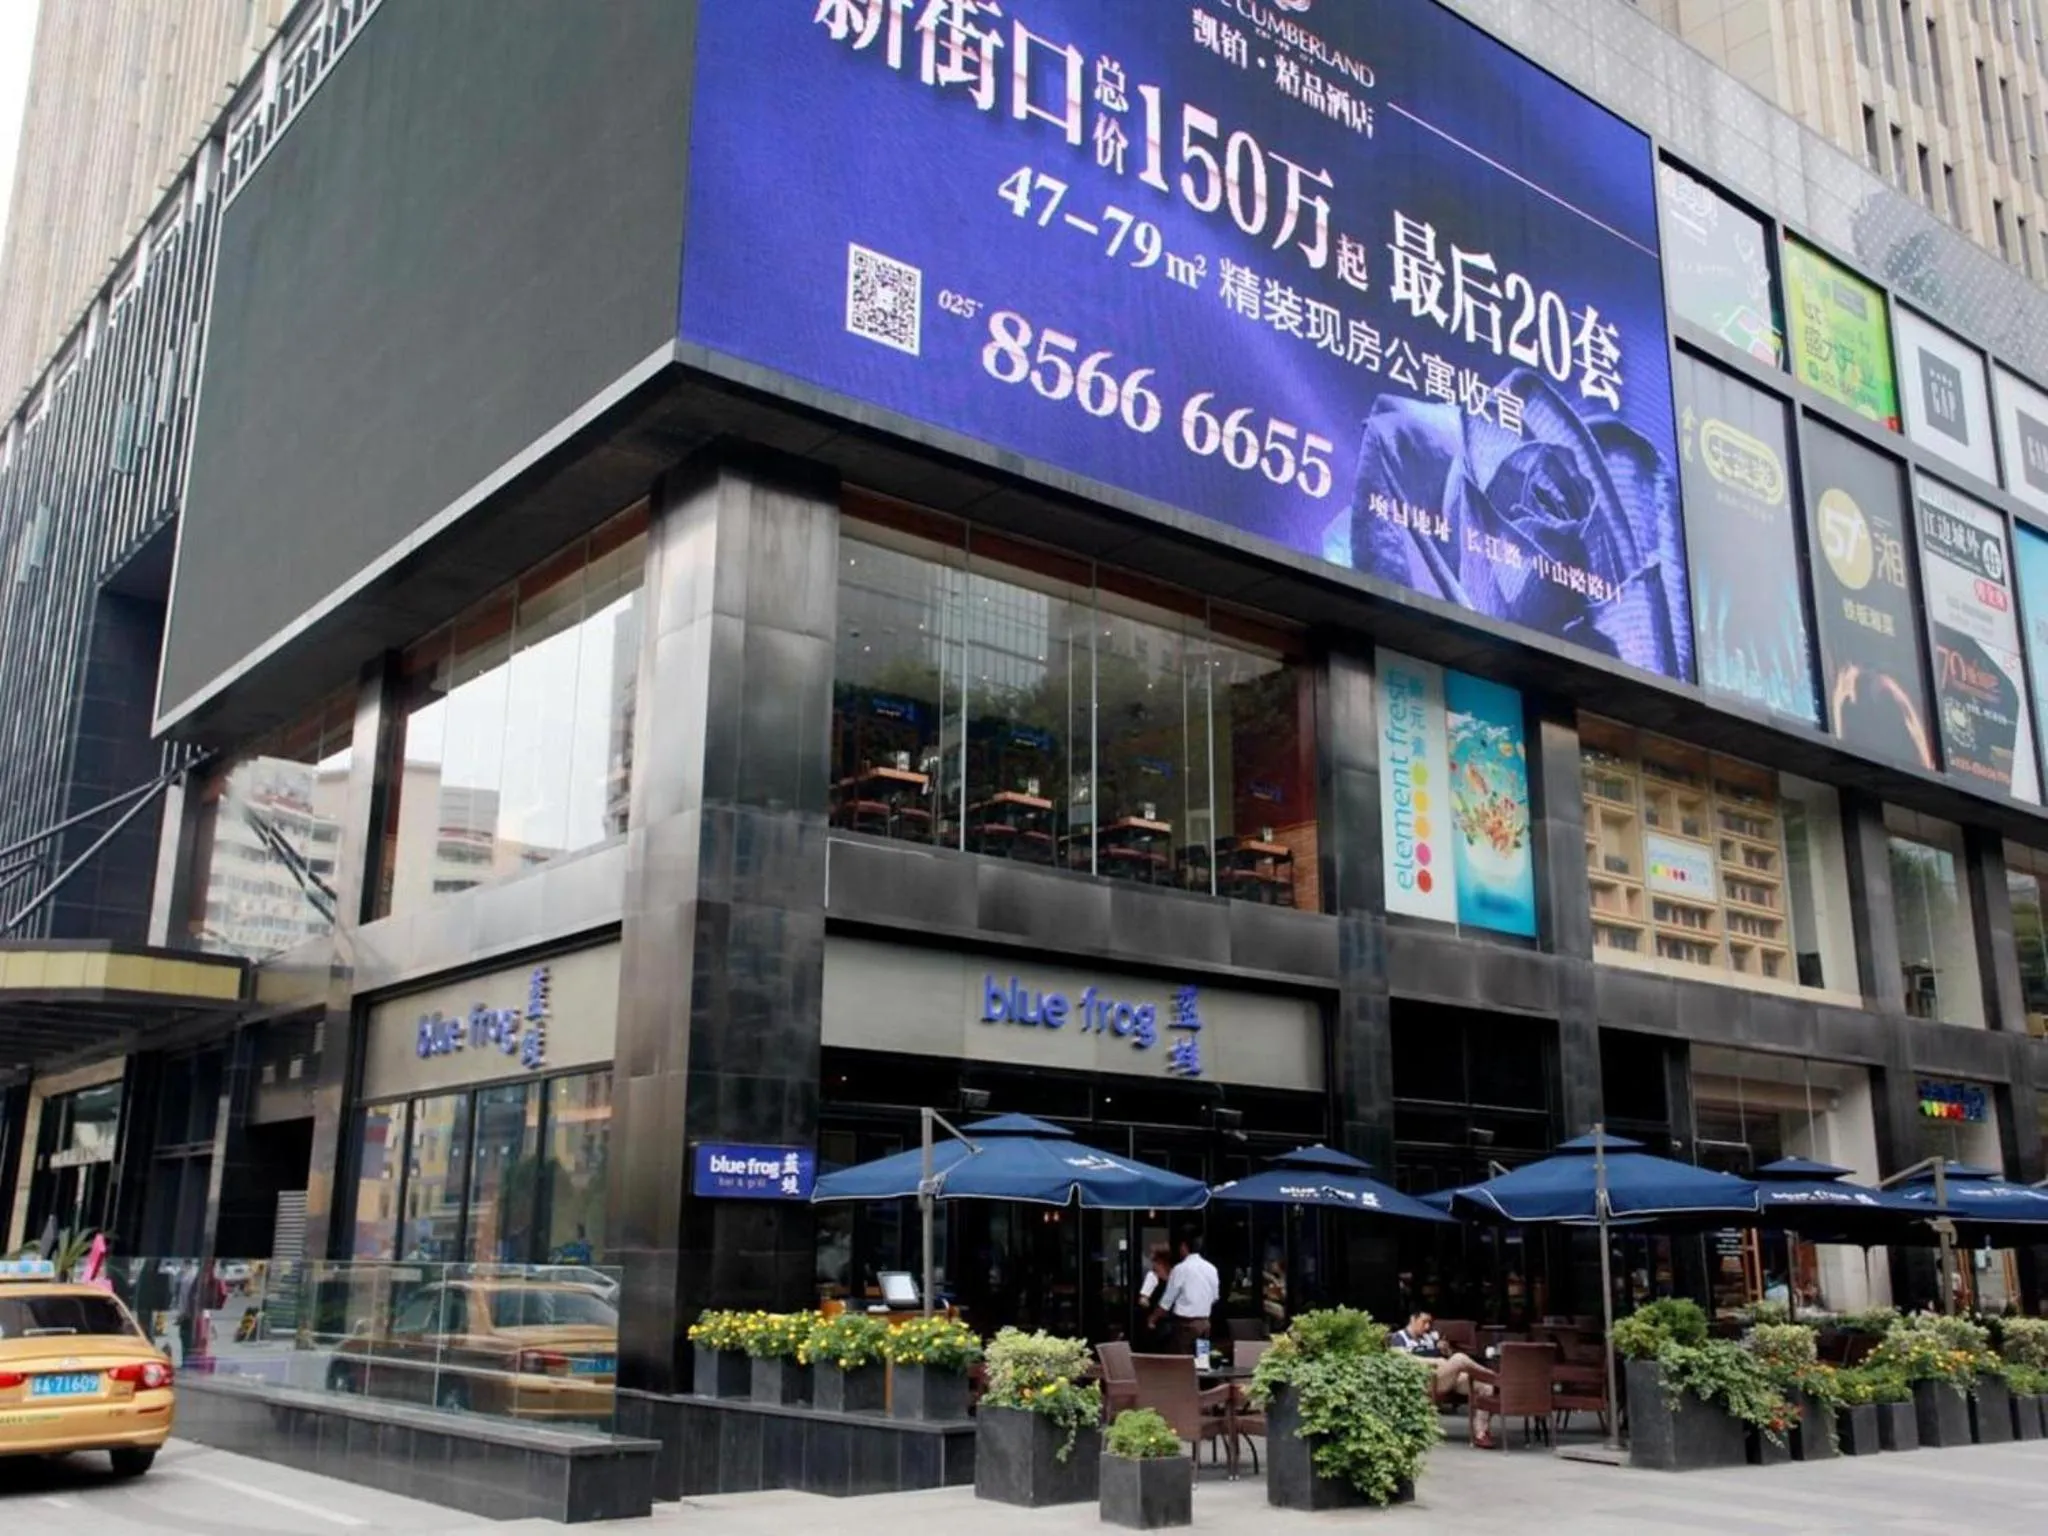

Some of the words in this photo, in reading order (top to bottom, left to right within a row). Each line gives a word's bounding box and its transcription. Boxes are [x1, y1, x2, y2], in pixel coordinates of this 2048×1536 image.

[1236, 0, 1375, 89] CUMBERLAND
[981, 310, 1162, 433] 8566
[1180, 392, 1334, 499] 6655
[1384, 668, 1409, 745] fresh
[1392, 751, 1416, 890] element
[982, 974, 1069, 1029] blue
[1077, 986, 1158, 1050] frog
[710, 1154, 745, 1175] blue
[747, 1157, 780, 1180] frog
